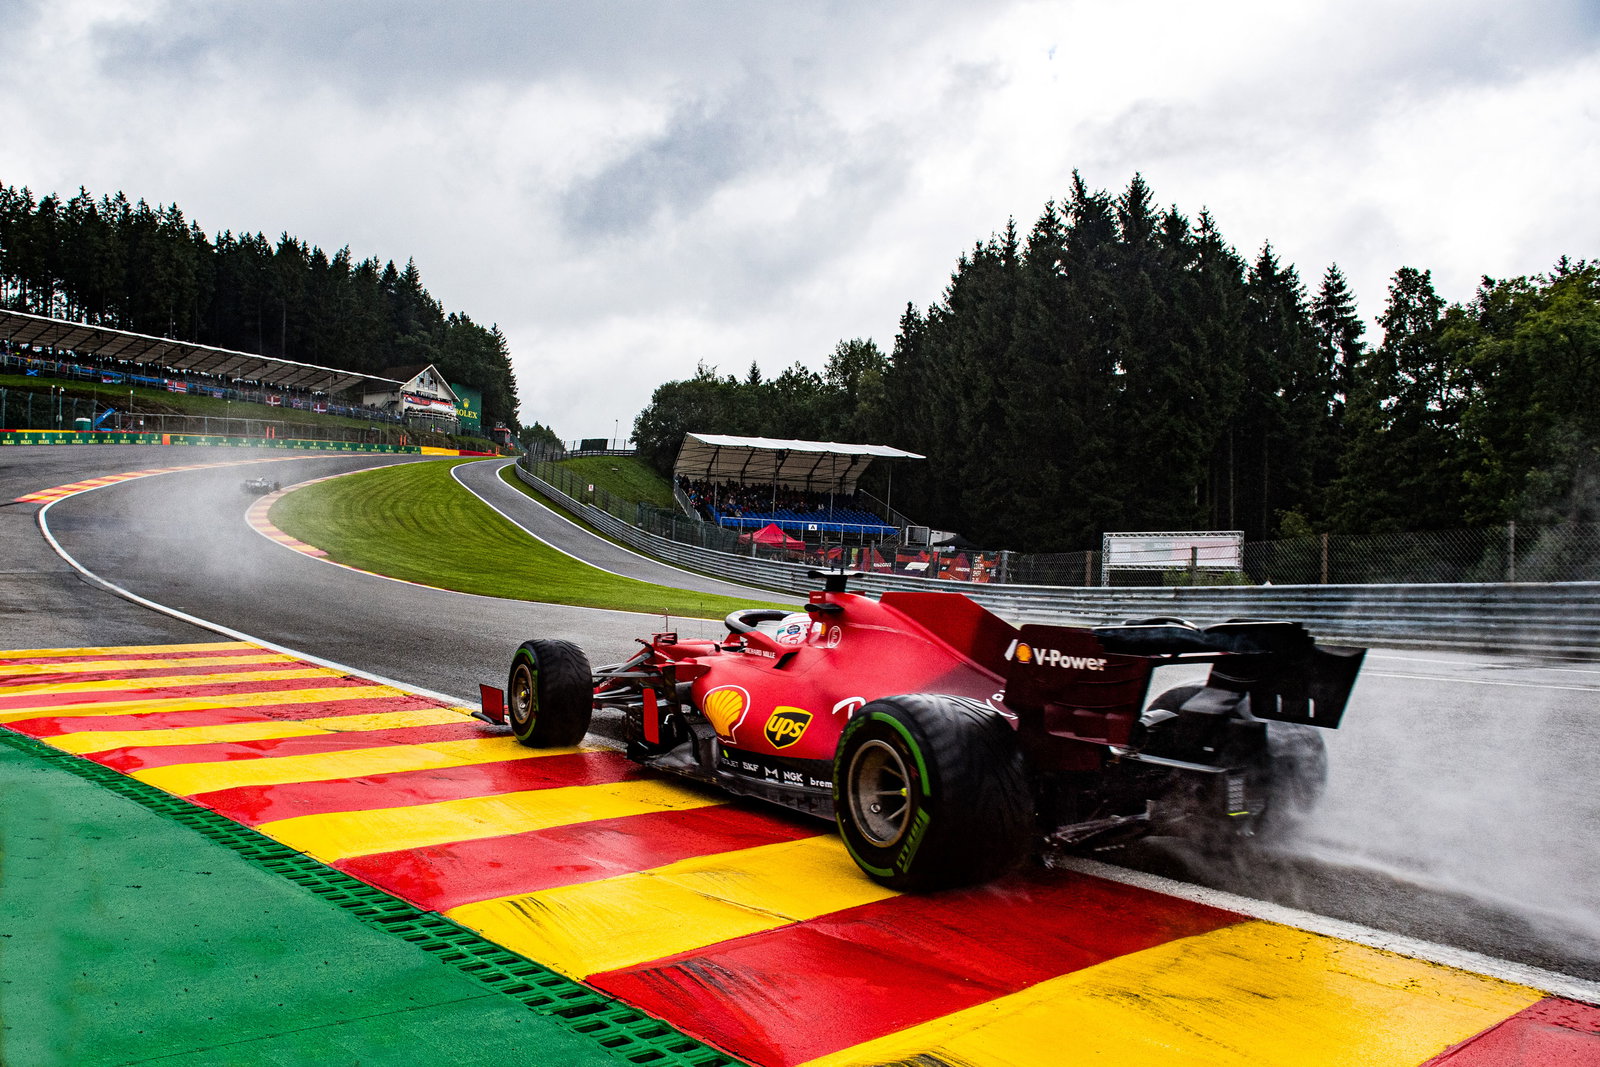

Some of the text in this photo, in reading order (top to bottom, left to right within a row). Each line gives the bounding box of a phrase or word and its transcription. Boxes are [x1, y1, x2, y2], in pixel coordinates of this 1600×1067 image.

[456, 408, 478, 419] ROLEX
[1032, 647, 1108, 672] V-Power
[767, 715, 806, 742] ups
[742, 761, 759, 772] SKF
[783, 771, 804, 783] NGK
[810, 777, 833, 788] brem
